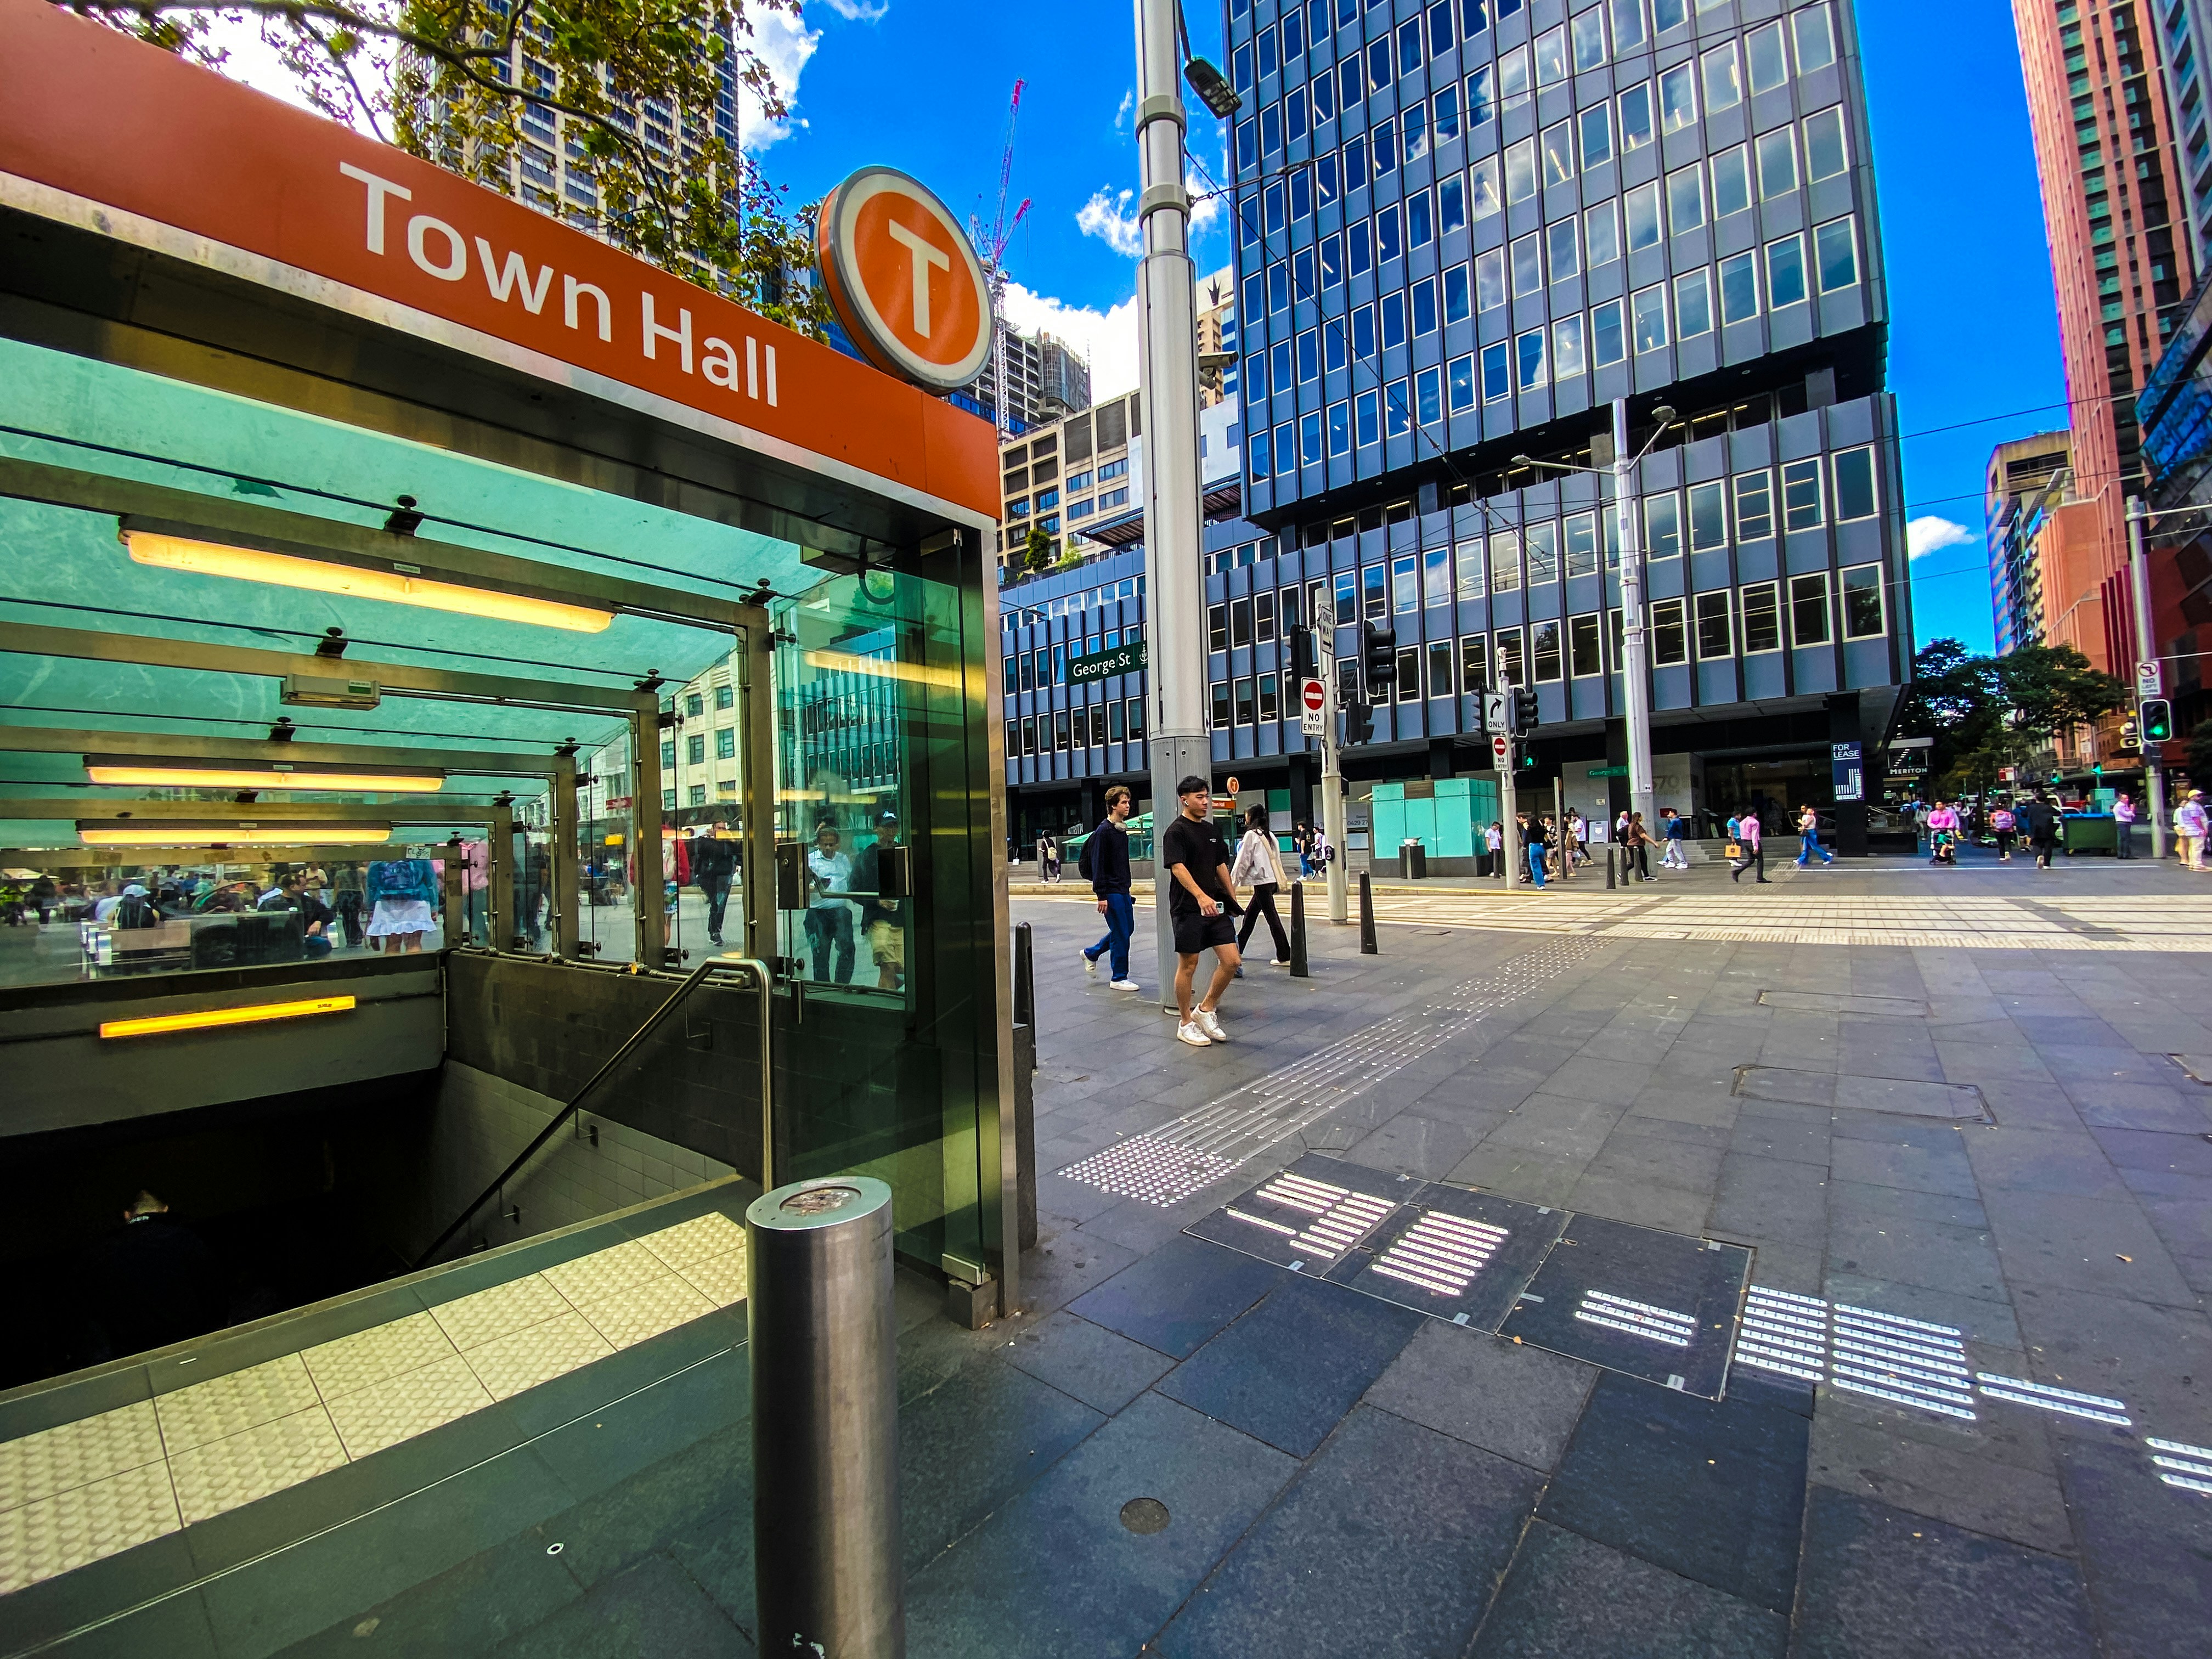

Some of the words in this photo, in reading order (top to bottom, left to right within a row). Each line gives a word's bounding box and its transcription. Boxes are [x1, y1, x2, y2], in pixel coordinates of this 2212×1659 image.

[338, 161, 612, 343] Town
[641, 292, 778, 408] Hall
[889, 219, 950, 340] T
[1323, 611, 1332, 625] ONE
[1323, 626, 1333, 639] WAY
[1073, 659, 1115, 677] George
[1119, 652, 1131, 667] St
[1308, 713, 1319, 721] NO
[1232, 781, 1236, 791] T
